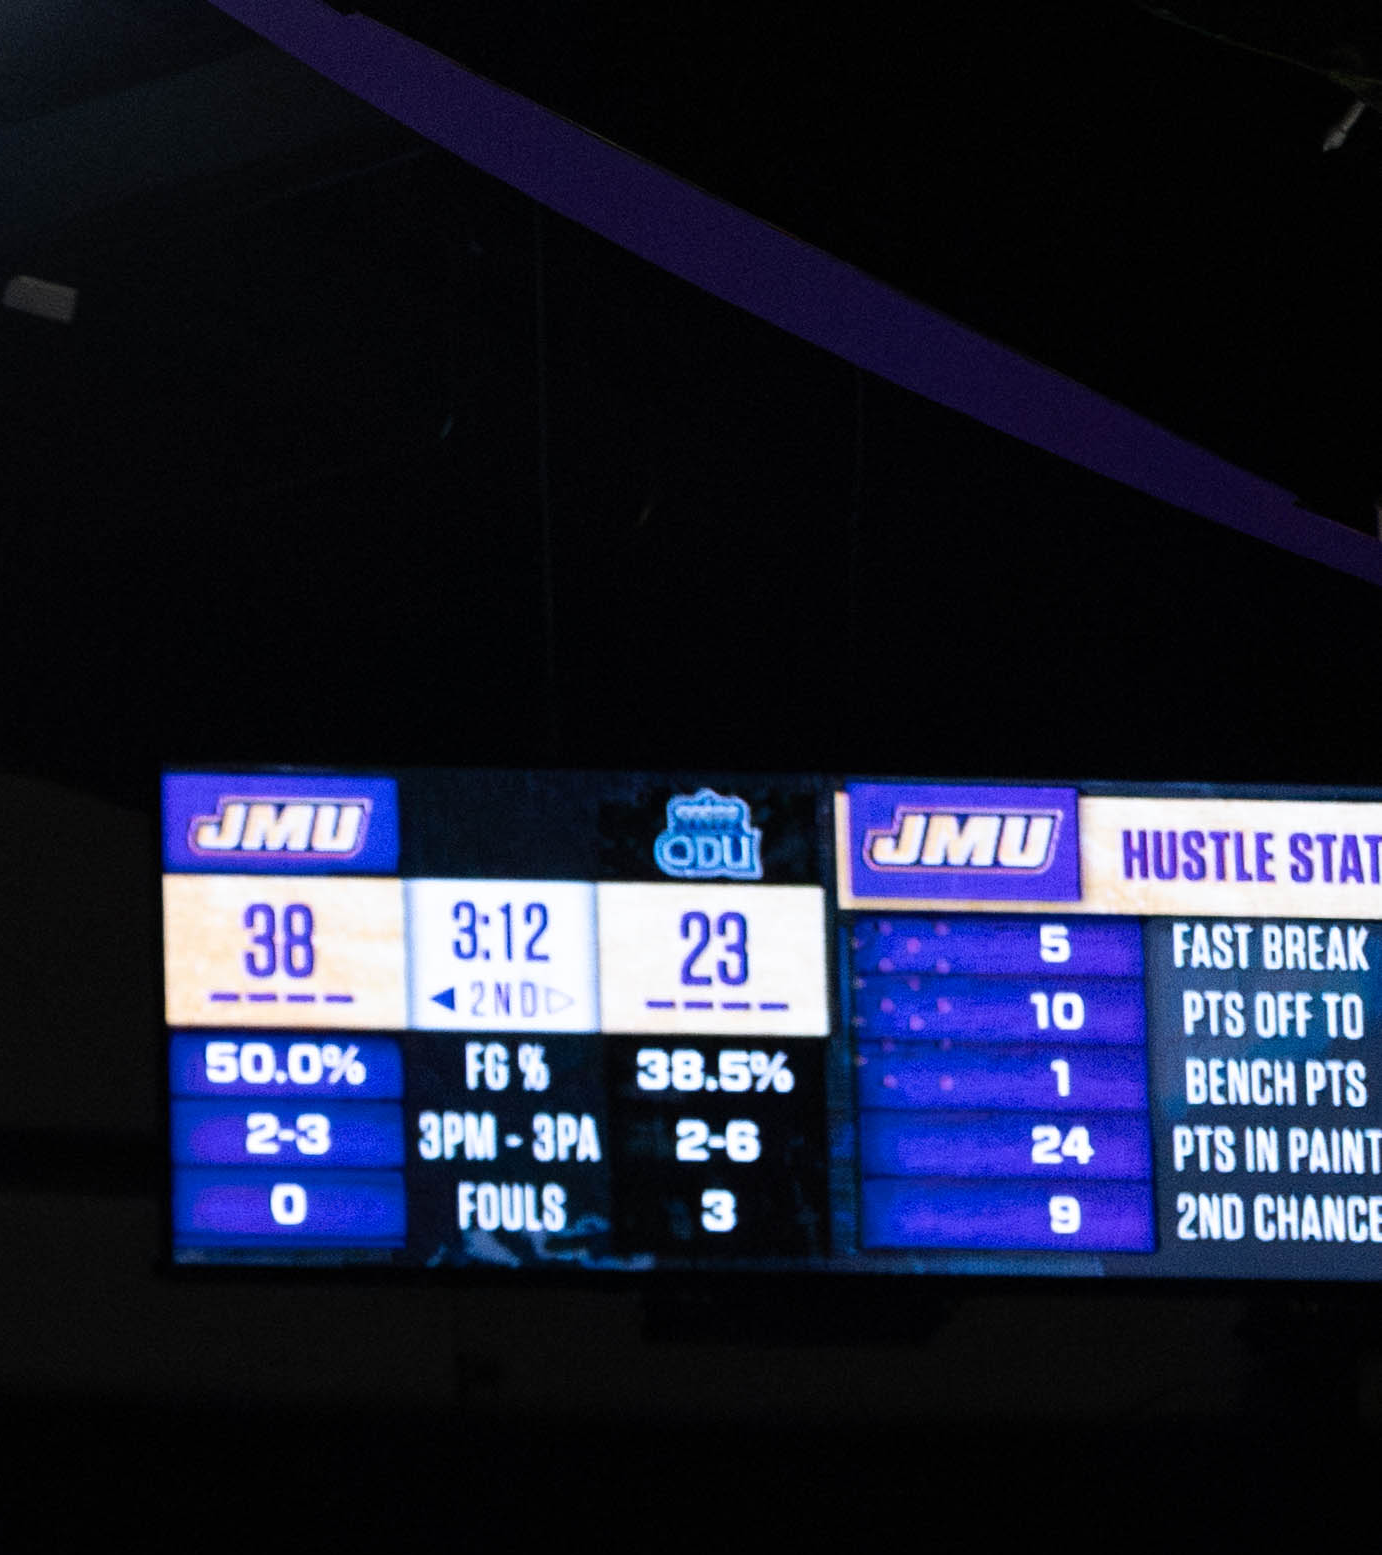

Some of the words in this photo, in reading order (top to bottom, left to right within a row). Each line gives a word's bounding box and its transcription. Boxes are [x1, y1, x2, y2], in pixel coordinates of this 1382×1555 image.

[192, 799, 369, 856] JMU
[661, 834, 752, 869] ODU
[867, 810, 1057, 870] JMU
[1122, 829, 1276, 882] HUSTLE
[243, 903, 316, 979] 38
[451, 900, 551, 963] 3:12
[679, 911, 749, 986] 23
[1039, 924, 1071, 963] 5
[1172, 922, 1250, 970] FAST
[1262, 926, 1370, 972] BREAK
[469, 980, 540, 1018] 2ND
[1030, 993, 1085, 1031] 10
[1184, 991, 1244, 1037] PTS
[1254, 992, 1312, 1039] OFF
[1323, 993, 1366, 1040] TO
[204, 1042, 367, 1086] 50.0%
[465, 1043, 510, 1090] FG
[517, 1045, 551, 1091] %
[635, 1049, 795, 1093] 38.5%
[1050, 1059, 1071, 1098] 1
[1185, 1059, 1297, 1107] BENCH
[1307, 1060, 1369, 1108] PTS
[245, 1113, 332, 1156] 2-3
[418, 1112, 497, 1162] 3PM
[532, 1114, 603, 1163] 3PA
[674, 1121, 761, 1163] 2-6
[1031, 1125, 1095, 1166] 24
[1173, 1126, 1234, 1173] PTS
[1245, 1127, 1280, 1174] IN
[1289, 1128, 1382, 1176] PAINT
[269, 1184, 308, 1226] 0
[458, 1183, 567, 1232] FOULS
[700, 1190, 737, 1234] 3
[1049, 1195, 1082, 1236] 9
[1176, 1194, 1244, 1241] 2ND
[1253, 1195, 1382, 1244] CHANCE
